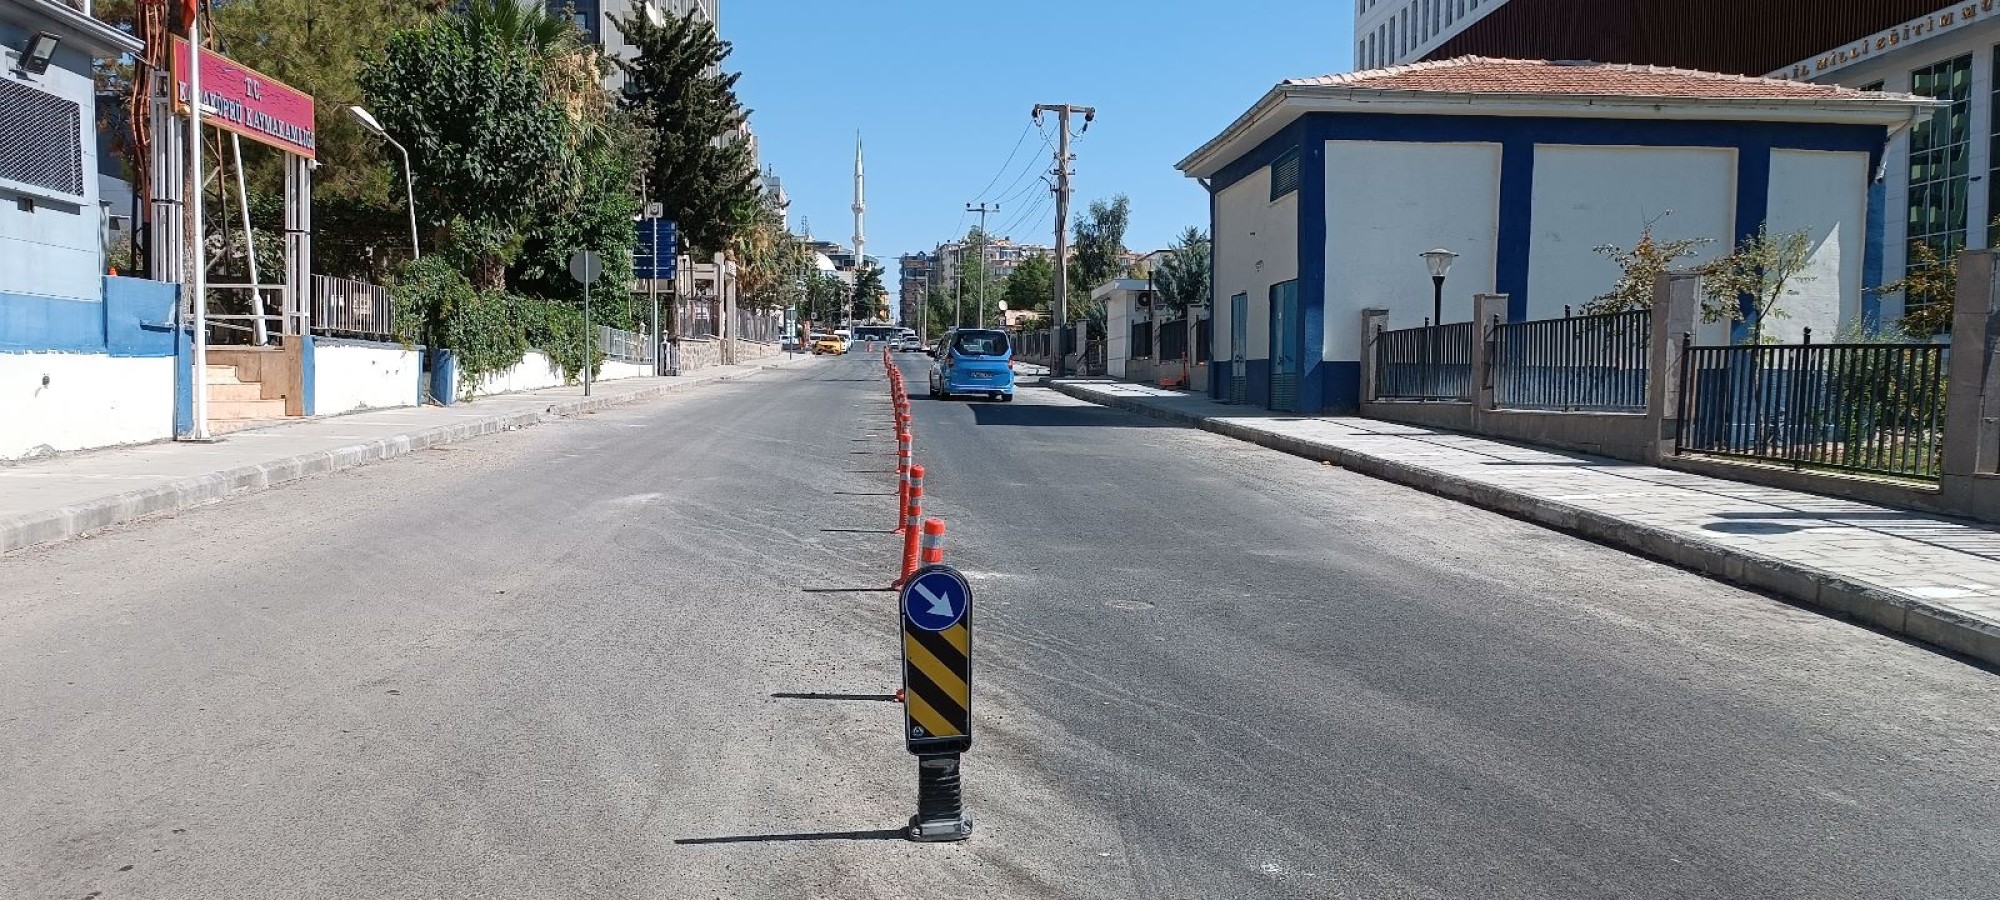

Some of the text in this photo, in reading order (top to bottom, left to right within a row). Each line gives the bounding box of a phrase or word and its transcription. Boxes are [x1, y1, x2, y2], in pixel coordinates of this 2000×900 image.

[1816, 39, 1870, 71] MİLLİ
[1875, 12, 1955, 50] EĞİTİM
[179, 80, 242, 123] KAKÖPRÜ
